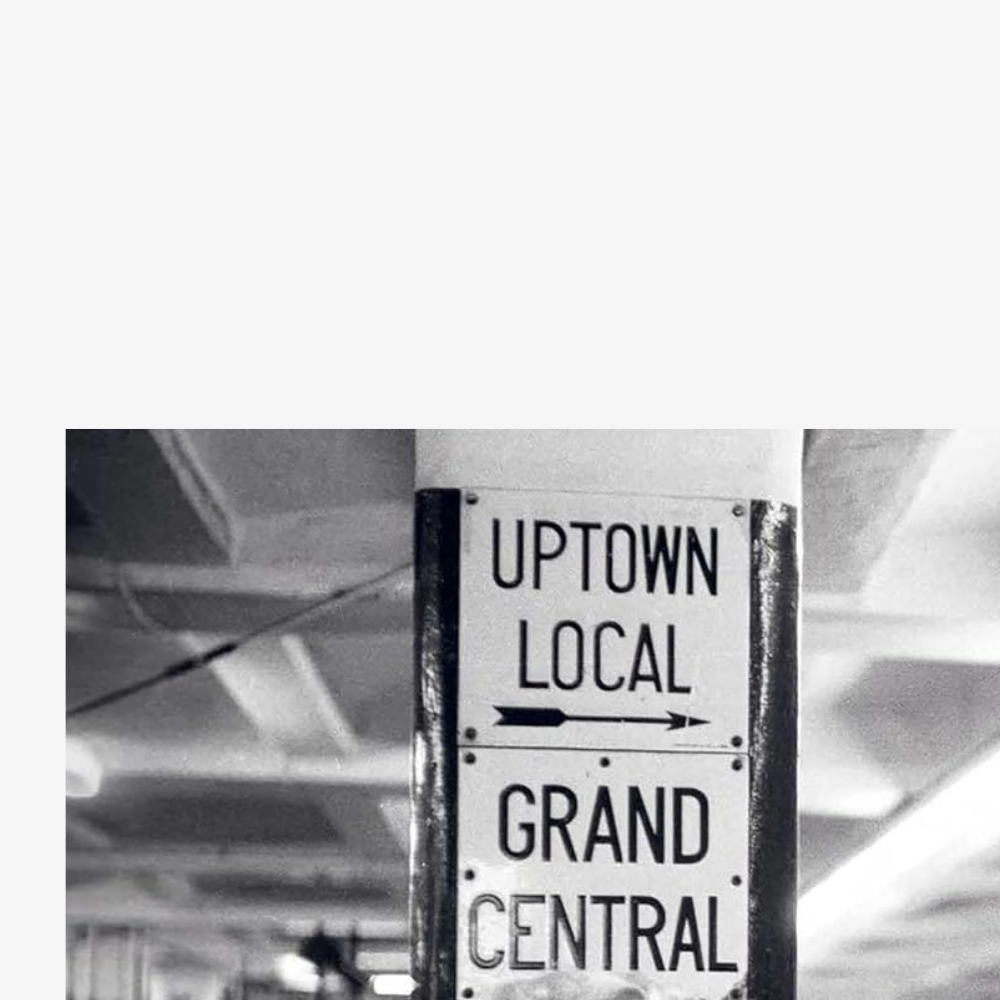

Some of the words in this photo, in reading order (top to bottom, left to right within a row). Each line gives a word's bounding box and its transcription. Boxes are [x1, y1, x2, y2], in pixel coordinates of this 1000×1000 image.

[492, 518, 718, 596] UPTOWN
[518, 619, 692, 694] LOCAL
[498, 783, 710, 865] GRAND
[468, 893, 739, 973] CENTRAL
